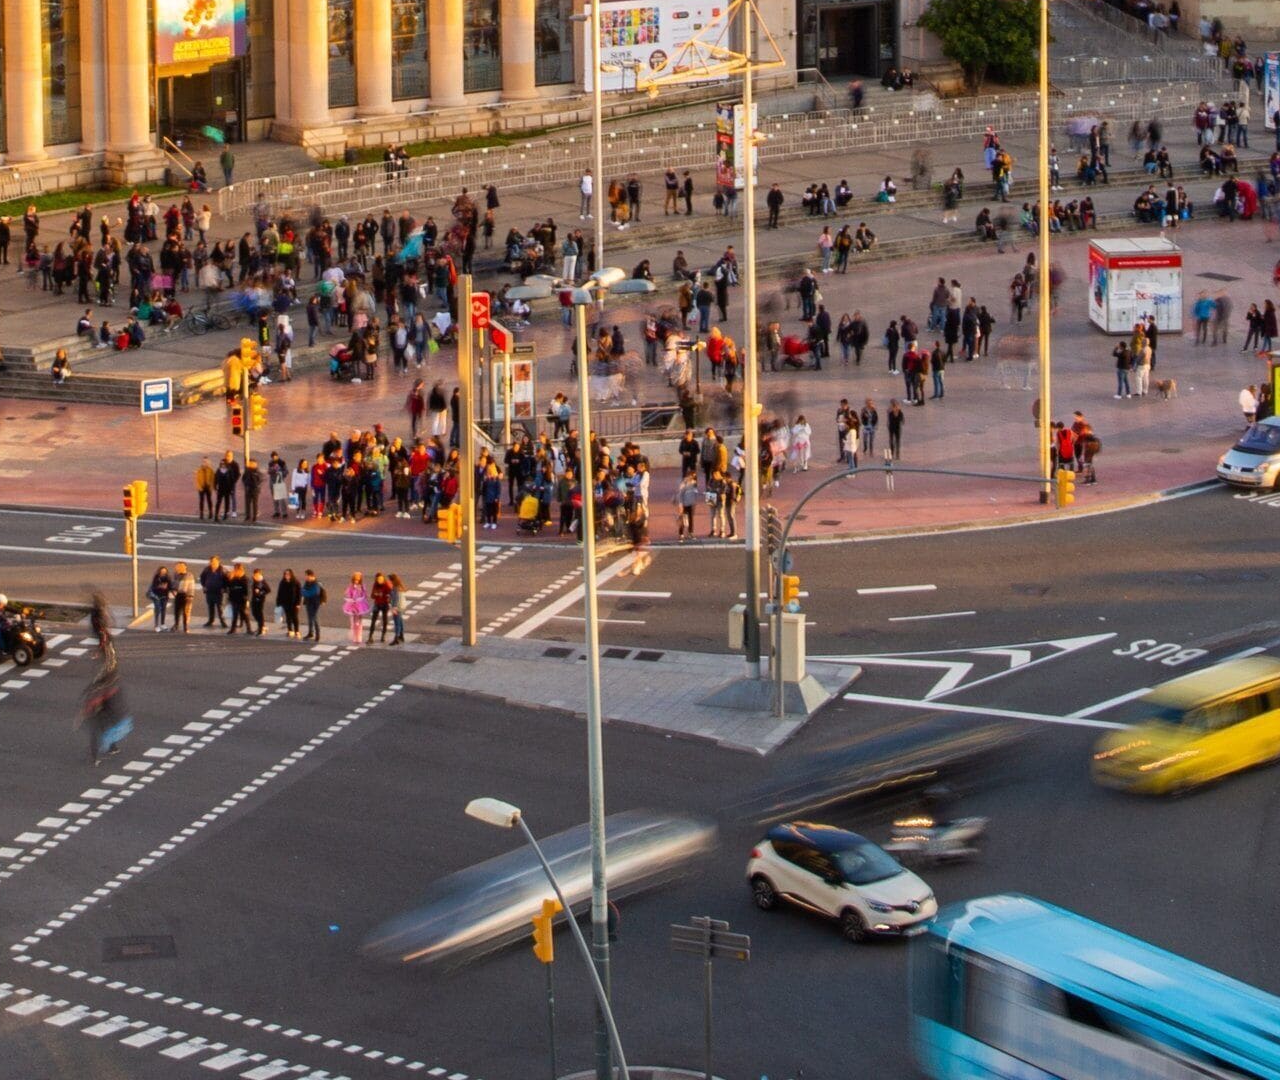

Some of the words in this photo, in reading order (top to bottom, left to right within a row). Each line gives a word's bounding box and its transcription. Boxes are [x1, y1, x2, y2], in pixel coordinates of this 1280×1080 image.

[45, 525, 116, 545] BUS
[137, 529, 207, 550] TAXI
[1112, 639, 1209, 666] BUS
